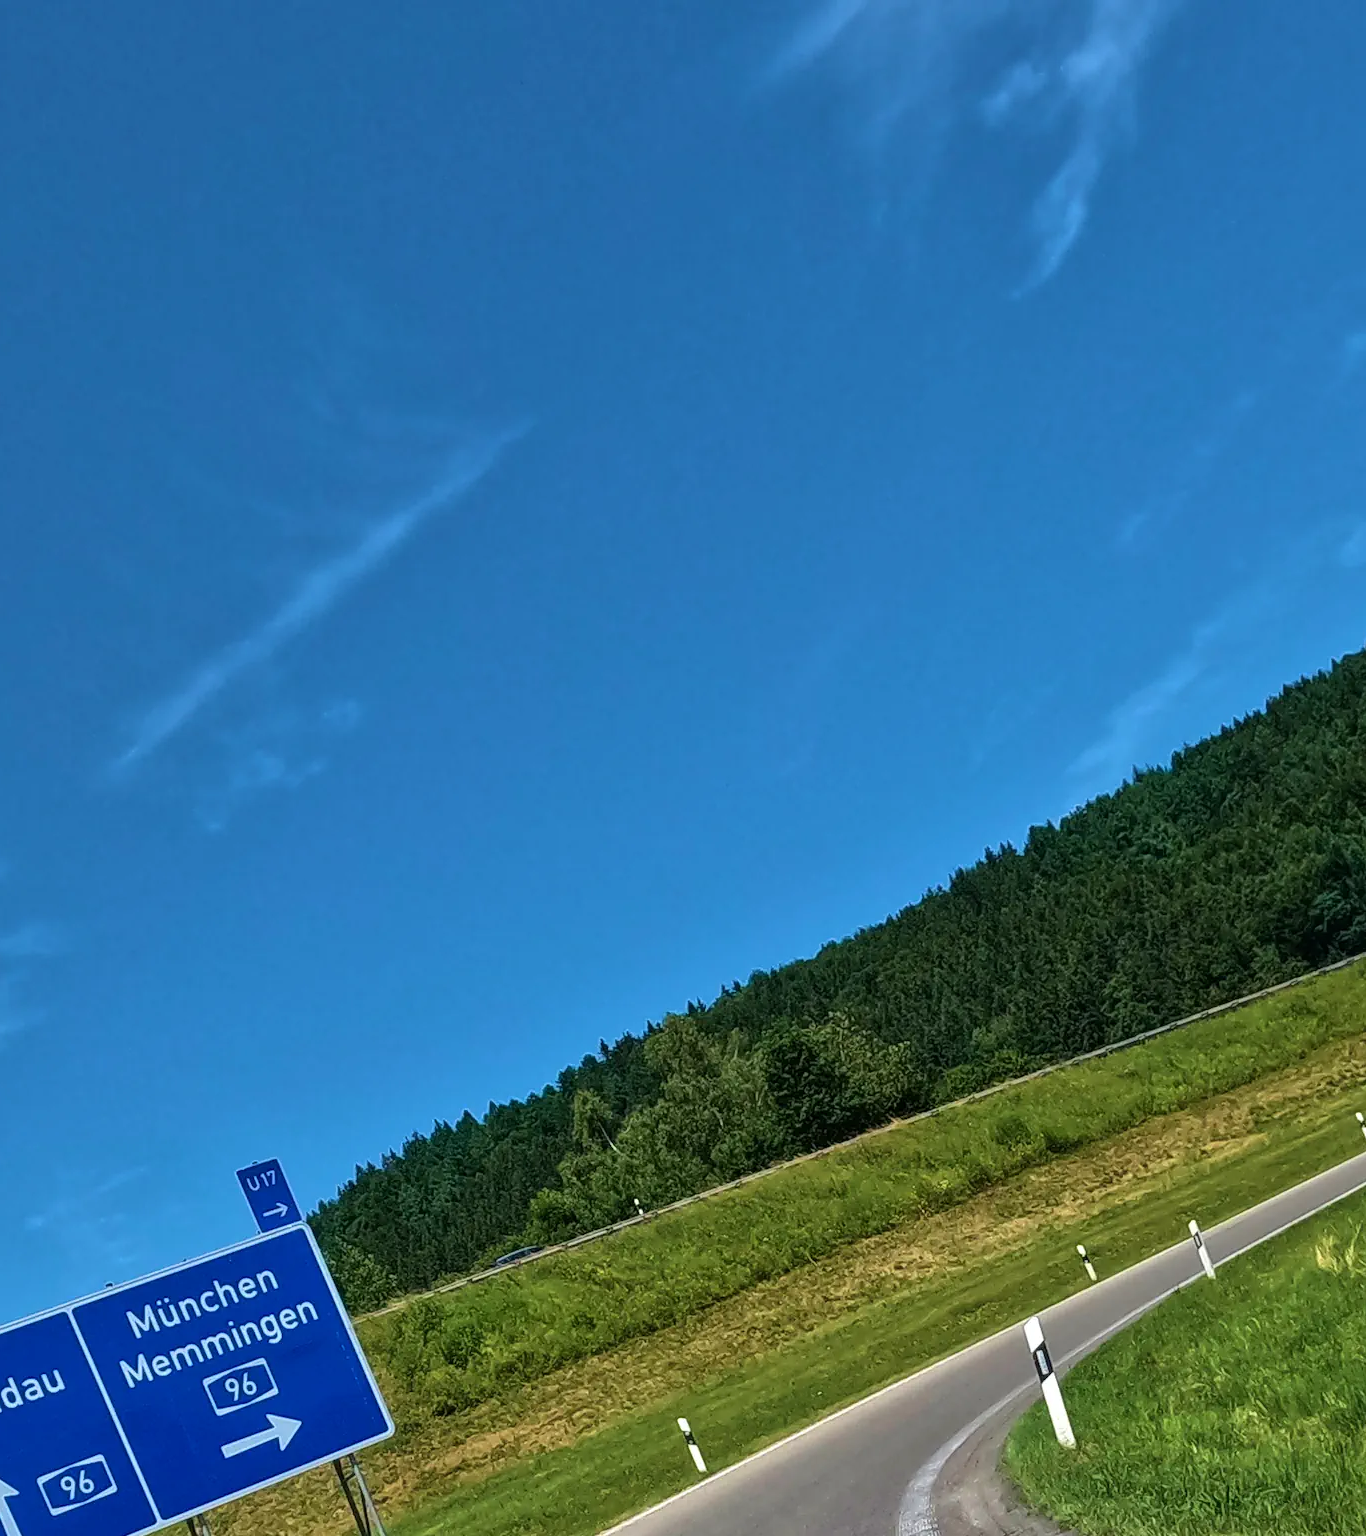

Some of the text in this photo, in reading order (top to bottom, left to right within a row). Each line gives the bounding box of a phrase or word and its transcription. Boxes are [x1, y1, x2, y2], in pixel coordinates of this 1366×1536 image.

[246, 1170, 276, 1191] U17
[126, 1269, 278, 1339] München
[119, 1301, 319, 1388] Memmingen
[225, 1372, 257, 1401] 96
[60, 1470, 95, 1500] 96
